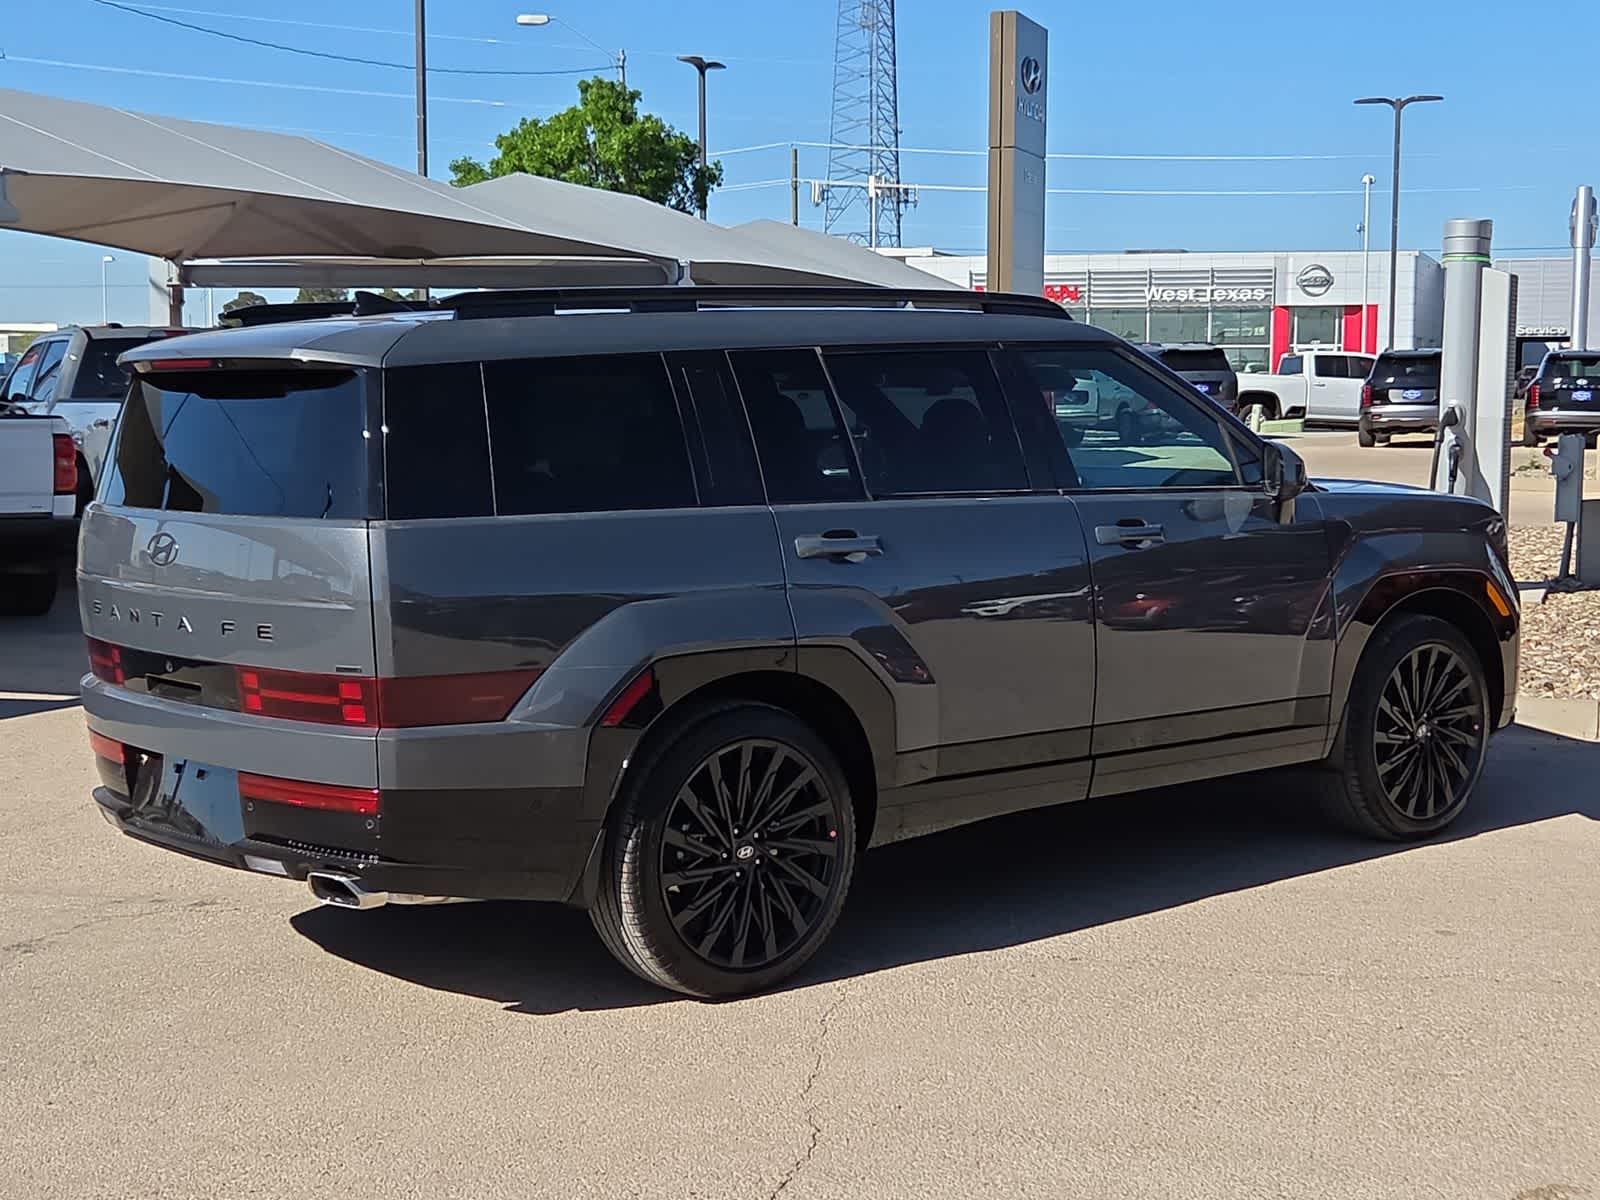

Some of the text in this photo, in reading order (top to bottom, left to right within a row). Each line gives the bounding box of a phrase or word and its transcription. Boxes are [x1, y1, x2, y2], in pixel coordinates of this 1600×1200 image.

[1145, 285, 1266, 302] West Texas
[1517, 325, 1568, 336] Service
[93, 600, 274, 642] SANTA FE
